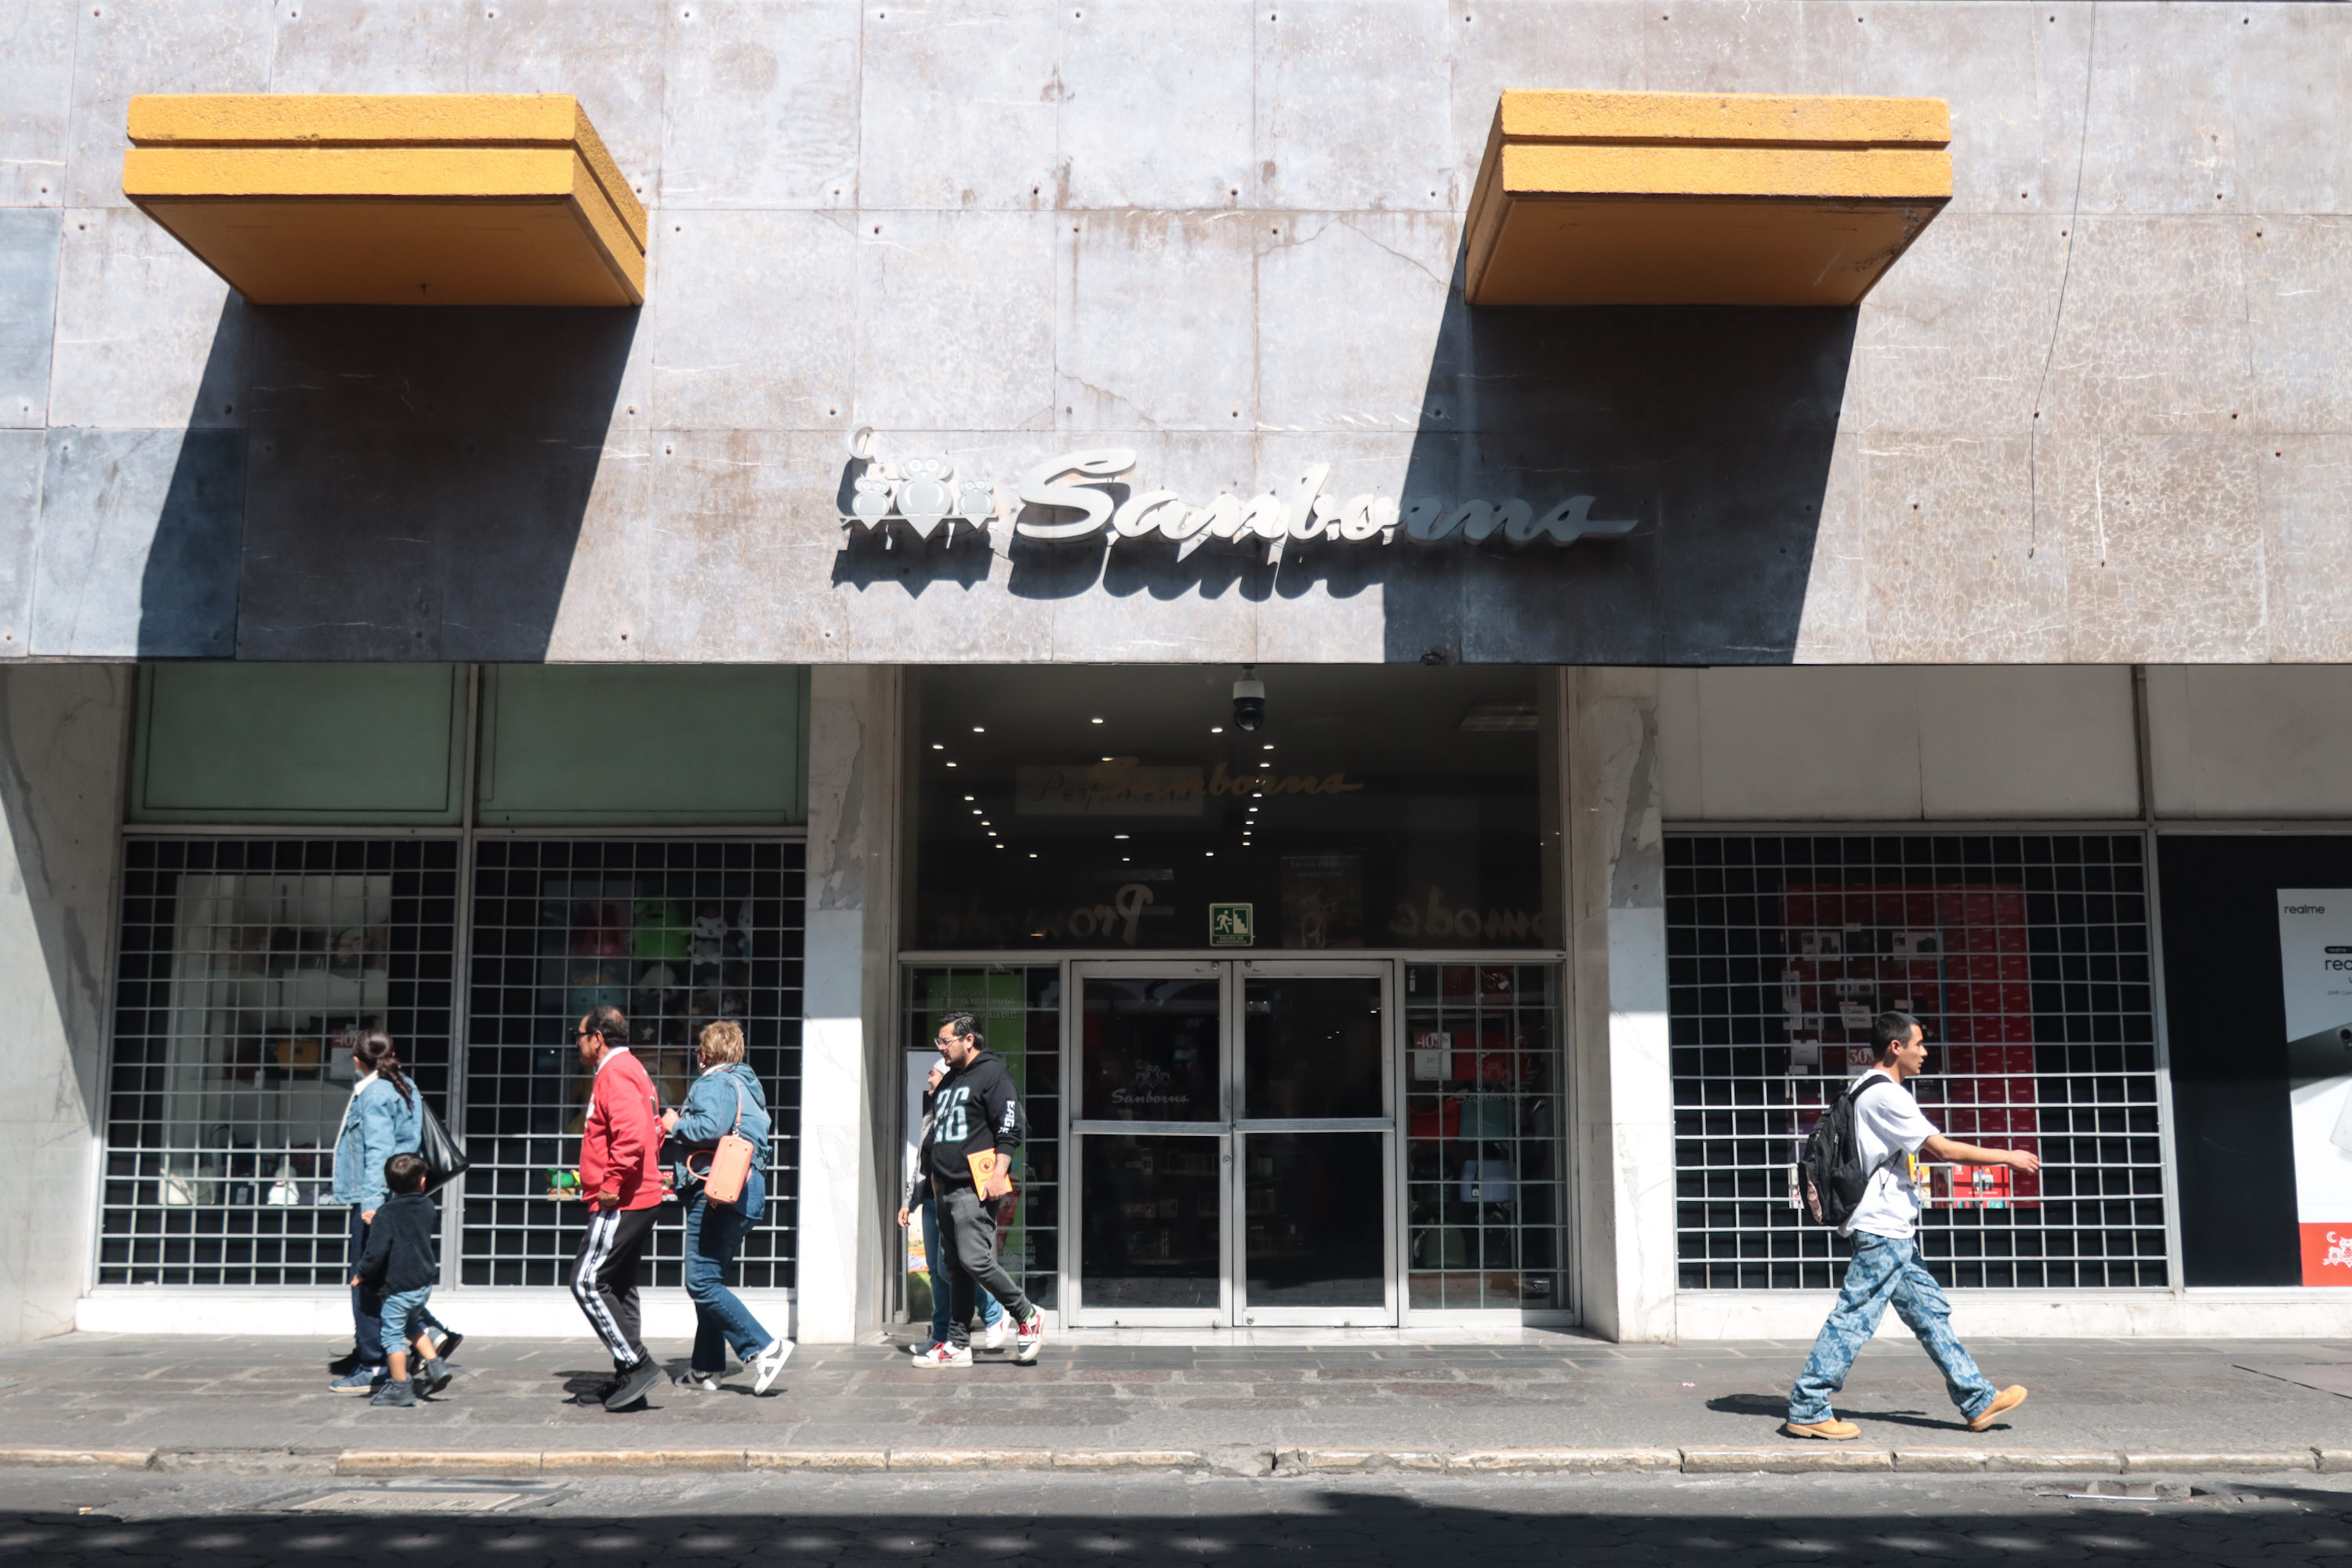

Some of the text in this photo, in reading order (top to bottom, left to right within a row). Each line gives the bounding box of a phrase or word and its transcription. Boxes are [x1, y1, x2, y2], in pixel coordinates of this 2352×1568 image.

[1015, 448, 1639, 546] Sanborns
[2284, 904, 2325, 914] realme
[1111, 1087, 1191, 1104] Sanborns
[933, 1085, 971, 1145] 26
